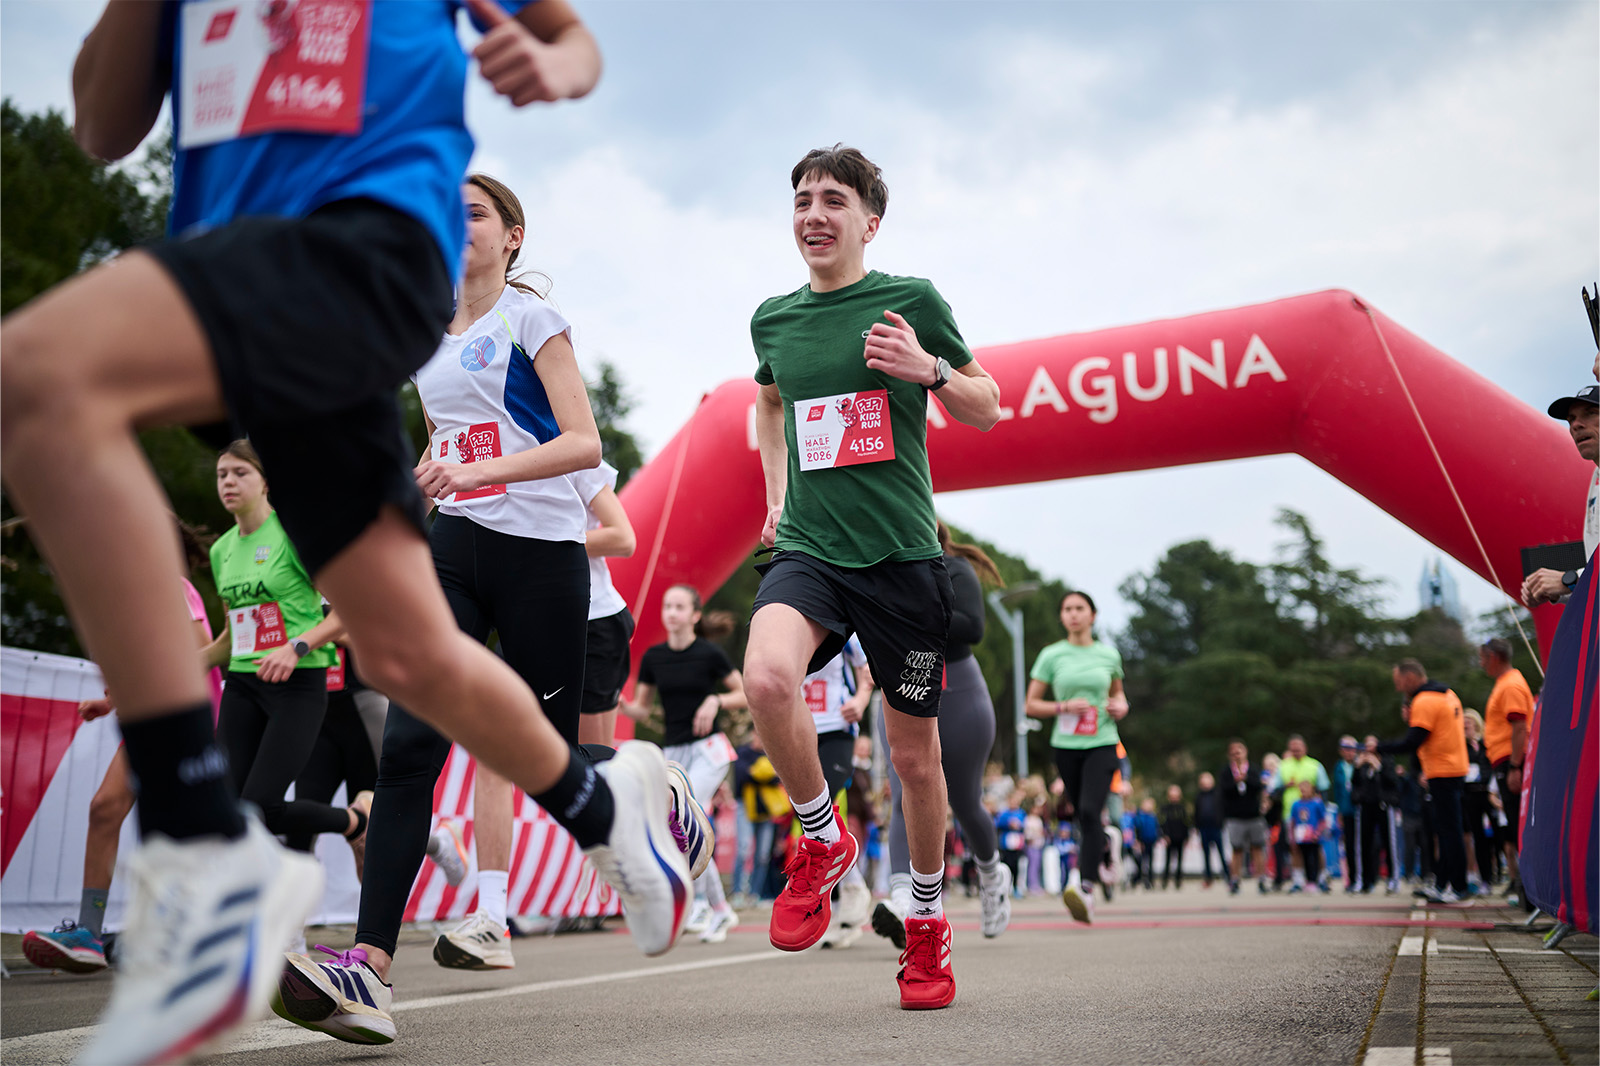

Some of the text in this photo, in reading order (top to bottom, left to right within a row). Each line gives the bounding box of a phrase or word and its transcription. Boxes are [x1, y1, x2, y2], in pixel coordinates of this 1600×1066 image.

[265, 73, 344, 109] 4164
[1000, 334, 1287, 424] AGUNA
[856, 397, 883, 413] PEPI
[860, 412, 881, 421] KIDS
[861, 420, 881, 429] RUN
[469, 431, 494, 447] PEPI
[805, 437, 829, 447] HALF
[849, 436, 884, 452] 4156
[474, 446, 492, 455] KIDS
[807, 450, 832, 462] 2026
[475, 454, 493, 462] RUN
[260, 630, 282, 643] 4172
[896, 683, 931, 702] NIKE
